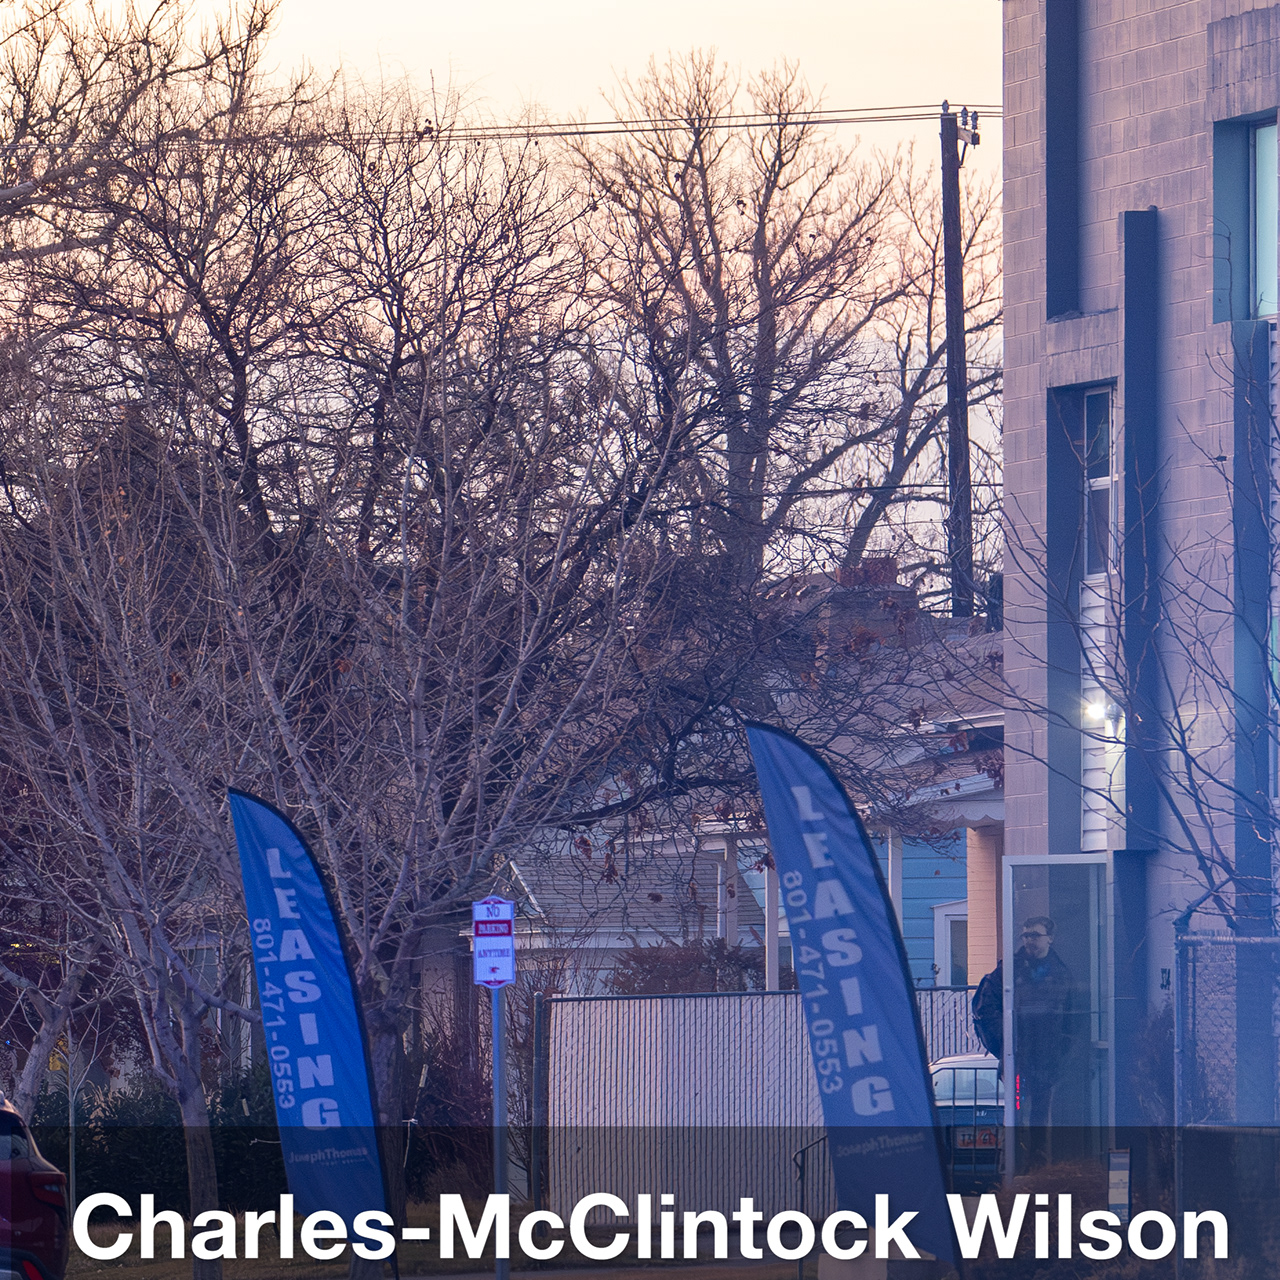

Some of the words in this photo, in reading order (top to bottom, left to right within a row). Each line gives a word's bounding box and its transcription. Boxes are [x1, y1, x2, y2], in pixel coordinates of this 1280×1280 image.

[265, 847, 341, 1131] LEASING
[486, 904, 500, 918] NO
[782, 869, 844, 1095] 801-471-0553
[790, 785, 895, 1117] LEASING
